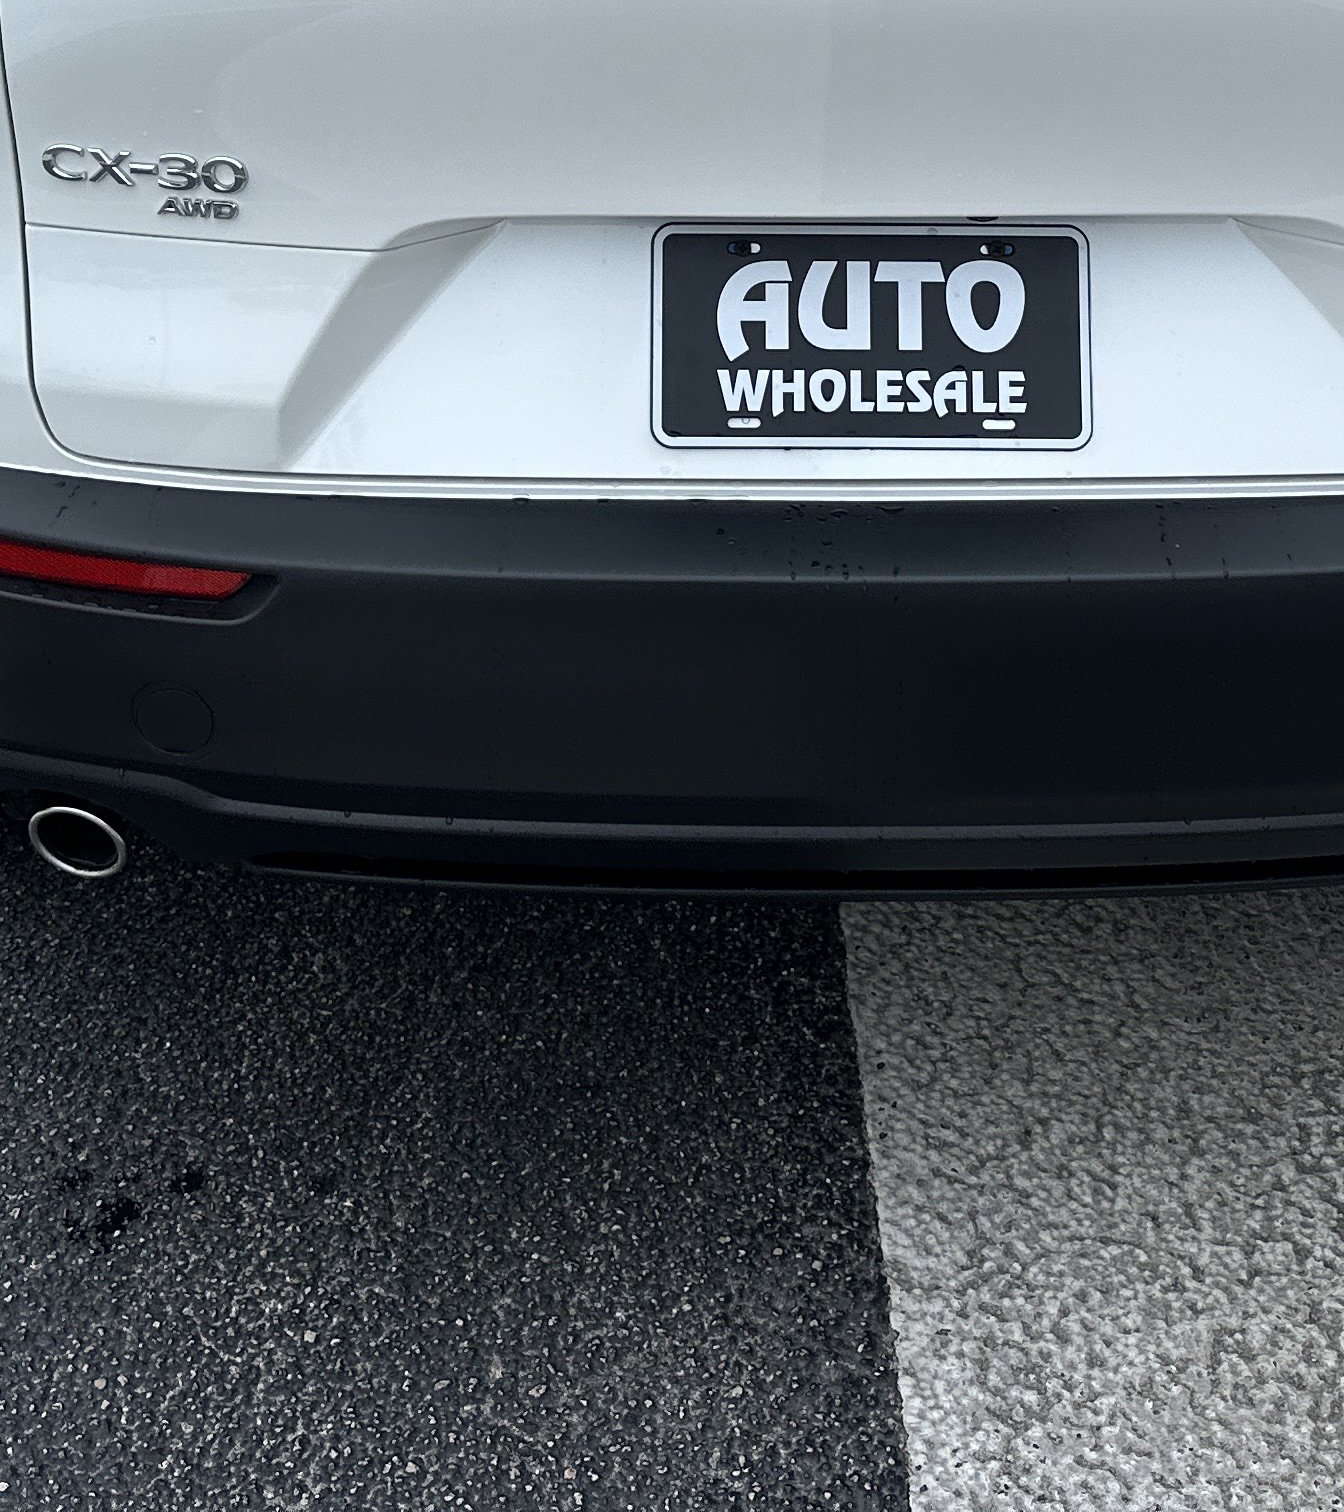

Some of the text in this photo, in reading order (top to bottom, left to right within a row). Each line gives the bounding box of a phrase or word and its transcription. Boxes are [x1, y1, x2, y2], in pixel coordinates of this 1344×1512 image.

[42, 143, 249, 194] CX-30
[157, 196, 239, 221] AWD
[716, 259, 1026, 362] AUTO
[716, 368, 1028, 419] WHOLESALE
